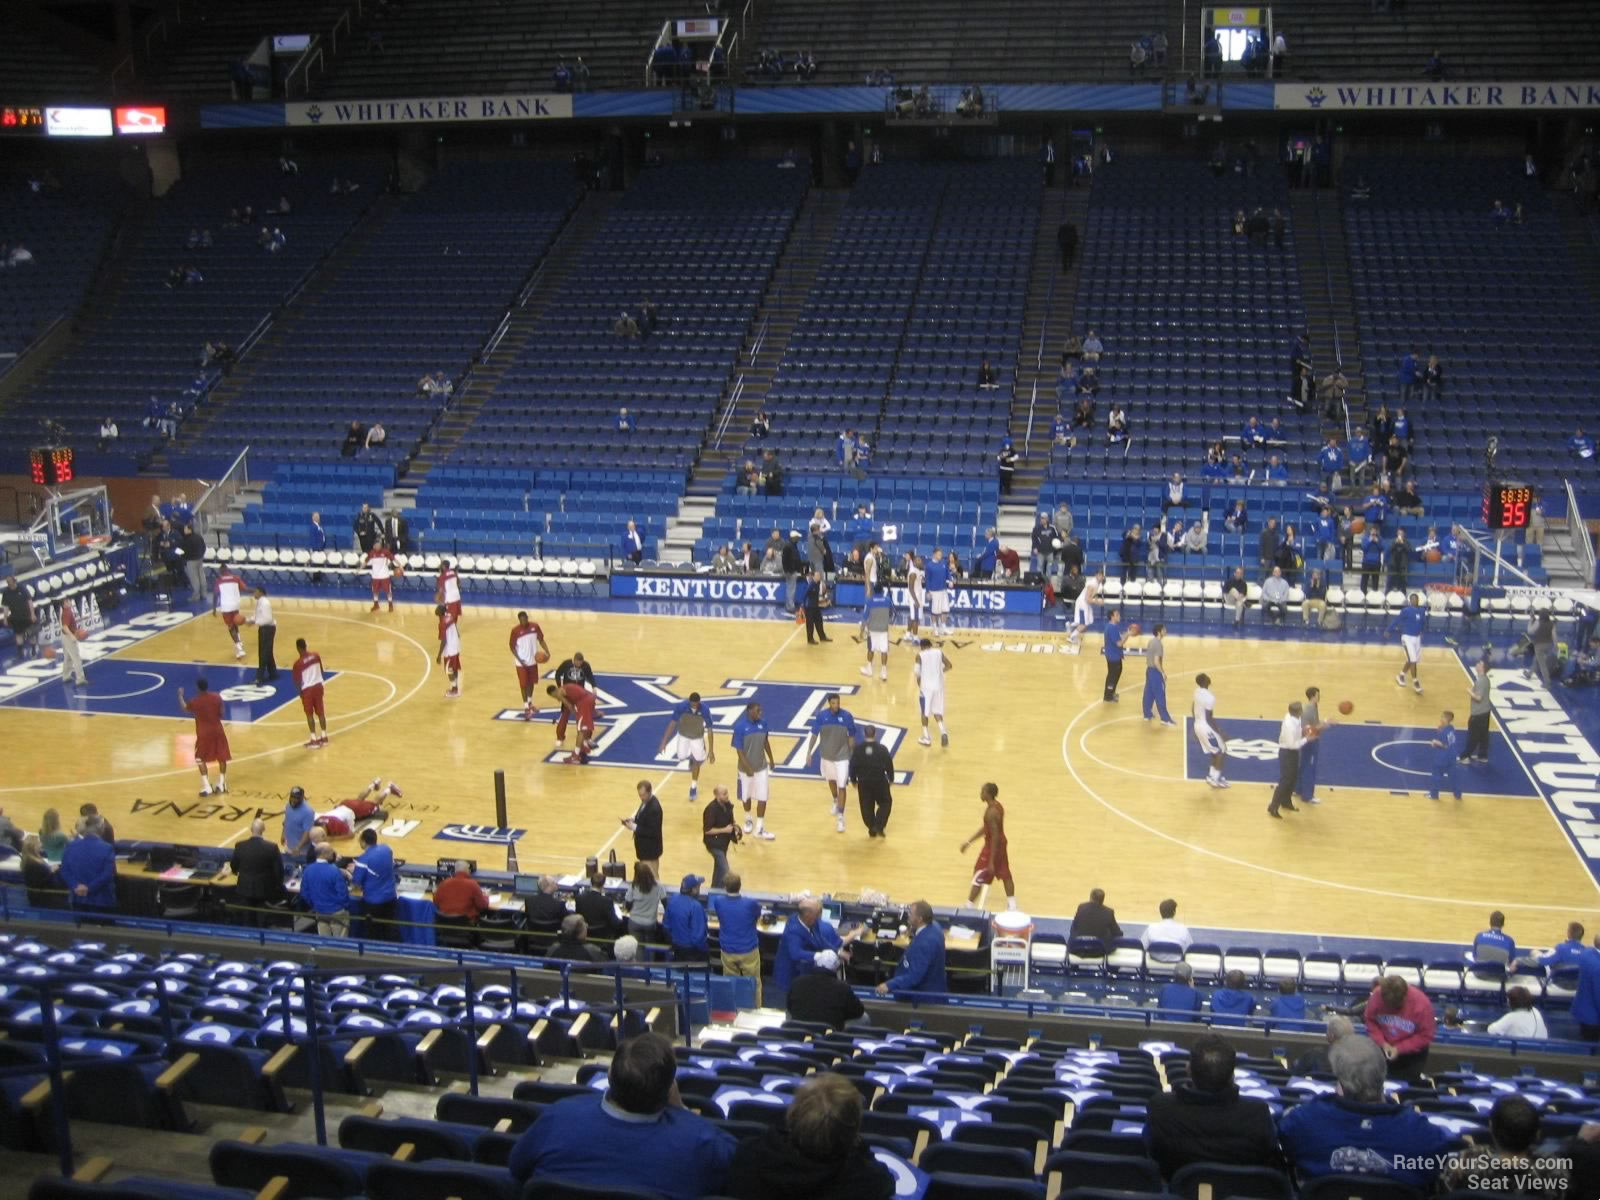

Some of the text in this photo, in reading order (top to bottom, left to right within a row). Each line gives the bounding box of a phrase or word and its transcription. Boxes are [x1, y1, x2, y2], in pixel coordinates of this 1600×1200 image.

[1337, 85, 1600, 106] WHITAKER BANK
[335, 98, 550, 121] WHITAKER BANK
[56, 461, 72, 482] 35
[1500, 489, 1530, 503] 58:33
[1502, 503, 1526, 526] 35
[635, 577, 781, 600] KENTUCKY
